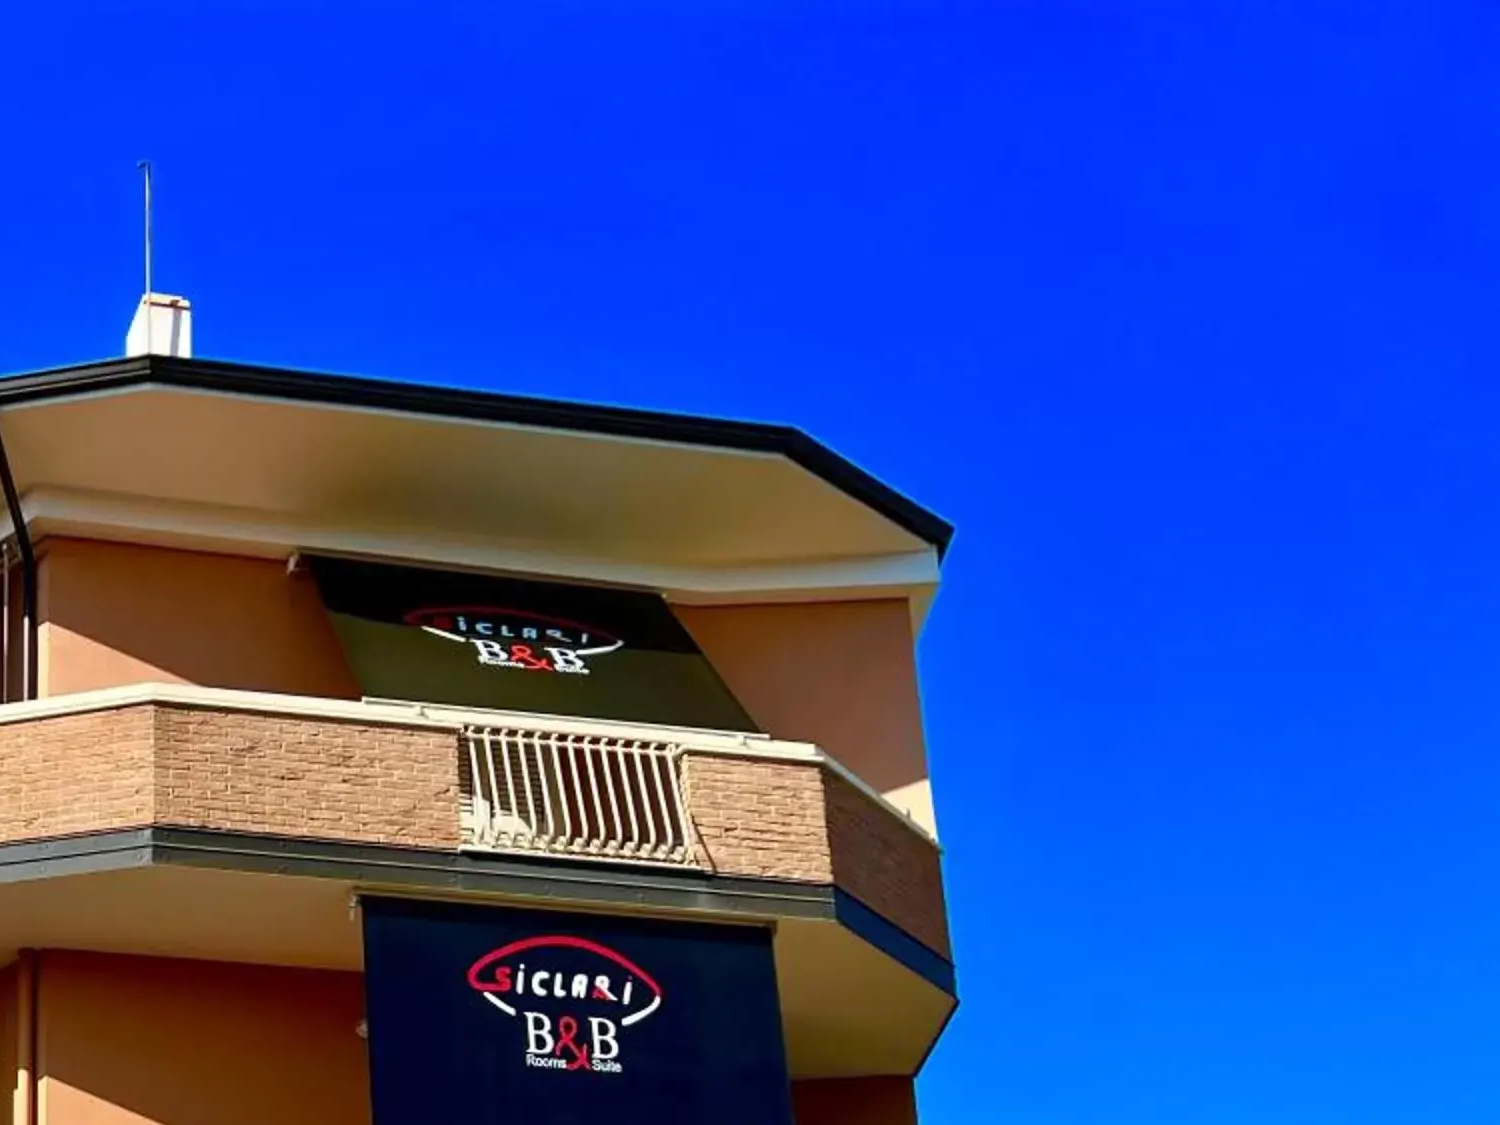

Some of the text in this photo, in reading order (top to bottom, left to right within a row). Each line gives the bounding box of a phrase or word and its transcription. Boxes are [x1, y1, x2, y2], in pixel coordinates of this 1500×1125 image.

[470, 638, 576, 671] B&B
[523, 1011, 620, 1069] B&B
[525, 1054, 622, 1073] Rooms Suite
